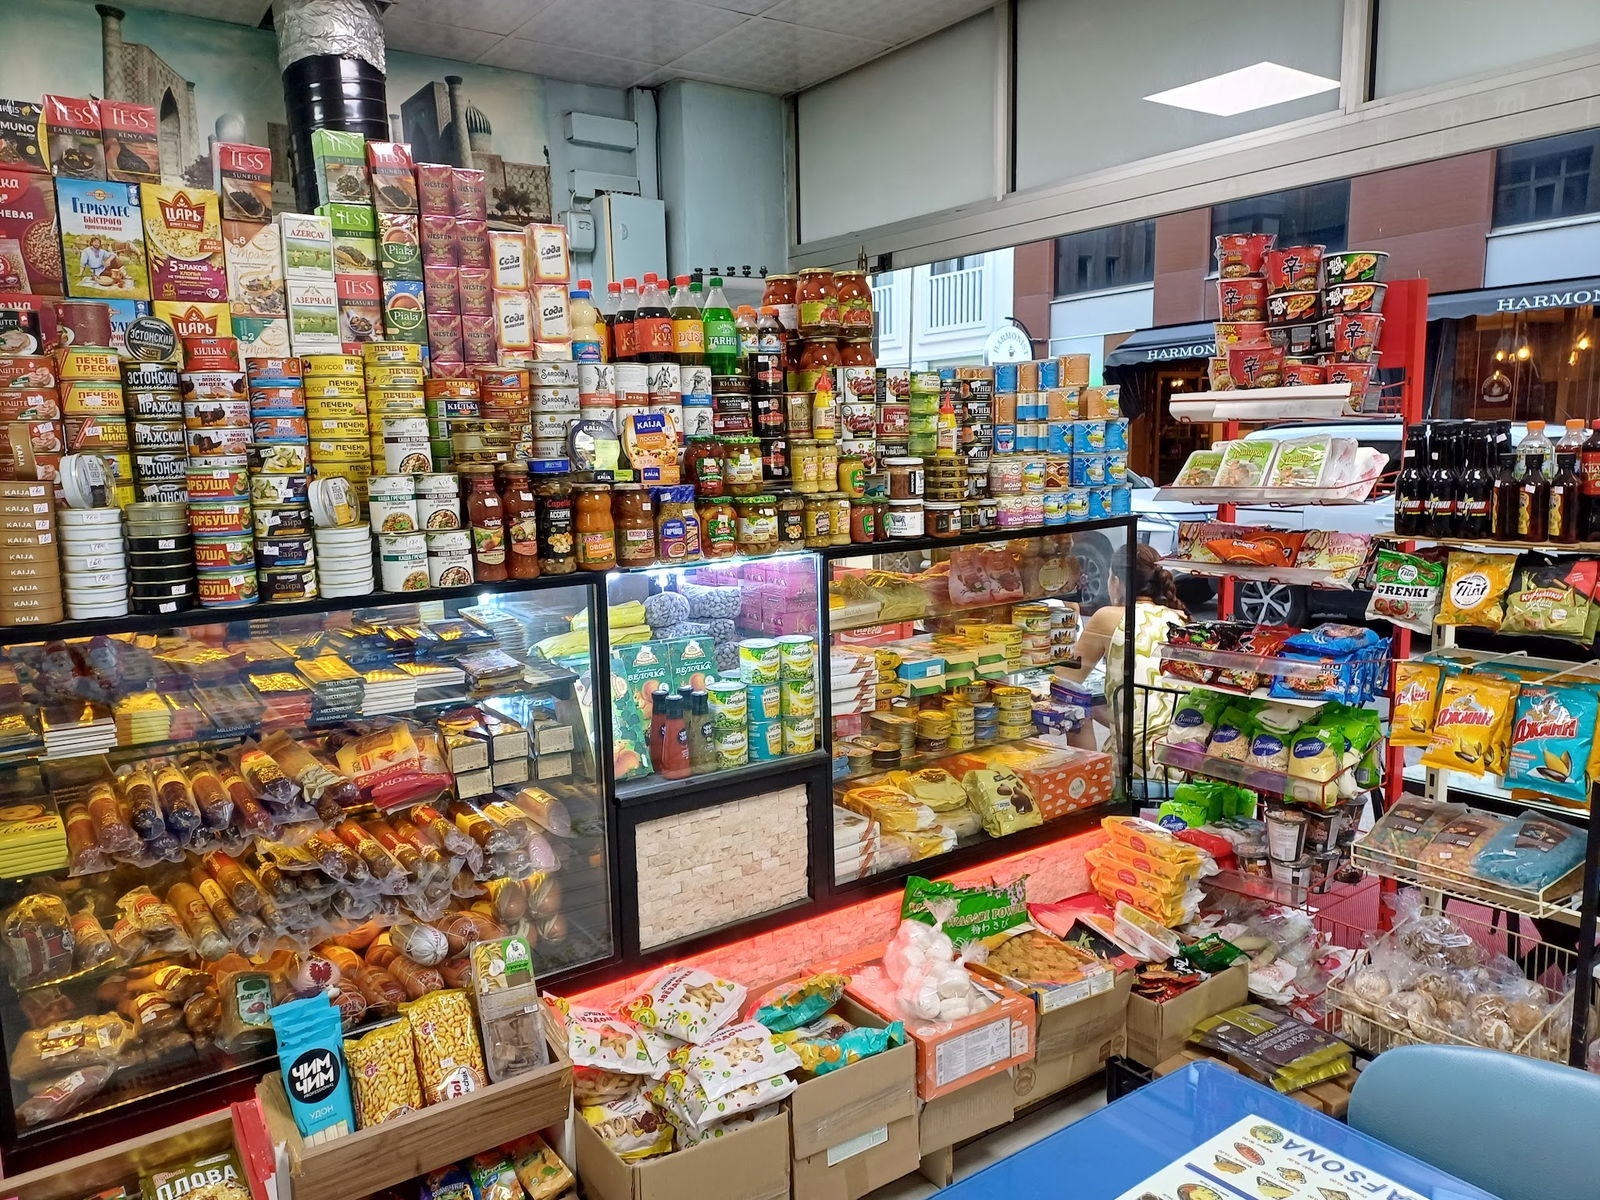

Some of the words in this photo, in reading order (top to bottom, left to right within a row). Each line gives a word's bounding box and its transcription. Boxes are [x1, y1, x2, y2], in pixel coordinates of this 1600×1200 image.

[53, 104, 94, 125] TESS
[110, 107, 148, 129] TESS
[53, 126, 72, 134] EARL
[75, 128, 95, 137] GREY
[118, 131, 144, 140] KENYA
[230, 151, 264, 170] TESS
[232, 172, 261, 181] SUNRISE
[380, 167, 407, 175] SUNRISE
[422, 180, 449, 189] WESTON
[71, 197, 130, 218] ГЕРКУЛЕС
[83, 215, 122, 226] БЫСТРОГО
[166, 207, 202, 223] ЦАРЬ
[336, 211, 369, 227] TESS
[290, 229, 325, 241] AZERÇAY
[388, 243, 413, 256] Piala
[540, 245, 561, 256] Сода
[169, 260, 178, 272] 5
[178, 263, 208, 272] ЗЛАКОВ
[499, 254, 520, 266] Сода
[1282, 255, 1304, 283] 辛
[343, 279, 375, 295] TESS
[430, 282, 455, 290] WESTON
[462, 283, 487, 291] WESTON
[294, 295, 332, 305] АЗЕРЧАЙ
[1224, 288, 1242, 314] 辛
[393, 311, 419, 321] Piala
[543, 306, 563, 317] Сода
[503, 312, 525, 324] Сода
[178, 322, 213, 336] ЦАРЬ
[432, 330, 458, 338] WESTON
[1344, 320, 1366, 348] 辛
[129, 329, 174, 345] ЭСТОНСКИЙ
[193, 346, 227, 356] КИЛЬКА
[374, 344, 408, 352] ПЕЧЕНЬ
[1147, 343, 1216, 361] HARMON
[76, 364, 118, 373] ТРЕСКИ
[1243, 355, 1264, 381] 辛
[127, 370, 178, 385] ЭСТОНСКИЙ
[719, 380, 745, 388] КИЛЬКА
[383, 391, 417, 399] ПЕЧЕНЬ
[583, 425, 604, 433] KAIJA
[637, 420, 662, 430] KAIJA
[15, 445, 25, 467] KAIJA
[645, 470, 659, 478] KAIJA
[190, 514, 240, 526] ГОРБУША
[9, 553, 34, 561] KAIJA
[10, 568, 36, 576] KAIJA
[12, 584, 38, 592] KAIJA
[275, 581, 301, 591] Сайра
[1378, 584, 1428, 598] GRENKI
[14, 599, 39, 607] KAIJA
[675, 663, 712, 675] БЕЛОЧКА
[627, 669, 666, 682] БЕЛОЧКА
[320, 705, 352, 714] MILLENNIUM
[216, 724, 251, 733] MILLENNIUM
[1513, 718, 1578, 745] ДЖИНН
[946, 909, 990, 927] WASABI
[291, 1052, 331, 1078] ЧИМ
[295, 1066, 335, 1094] ЧИМ
[303, 1081, 334, 1099] PROFESSIONAL
[309, 1104, 333, 1120] УДОН
[157, 1164, 238, 1200] ПЛОВА
